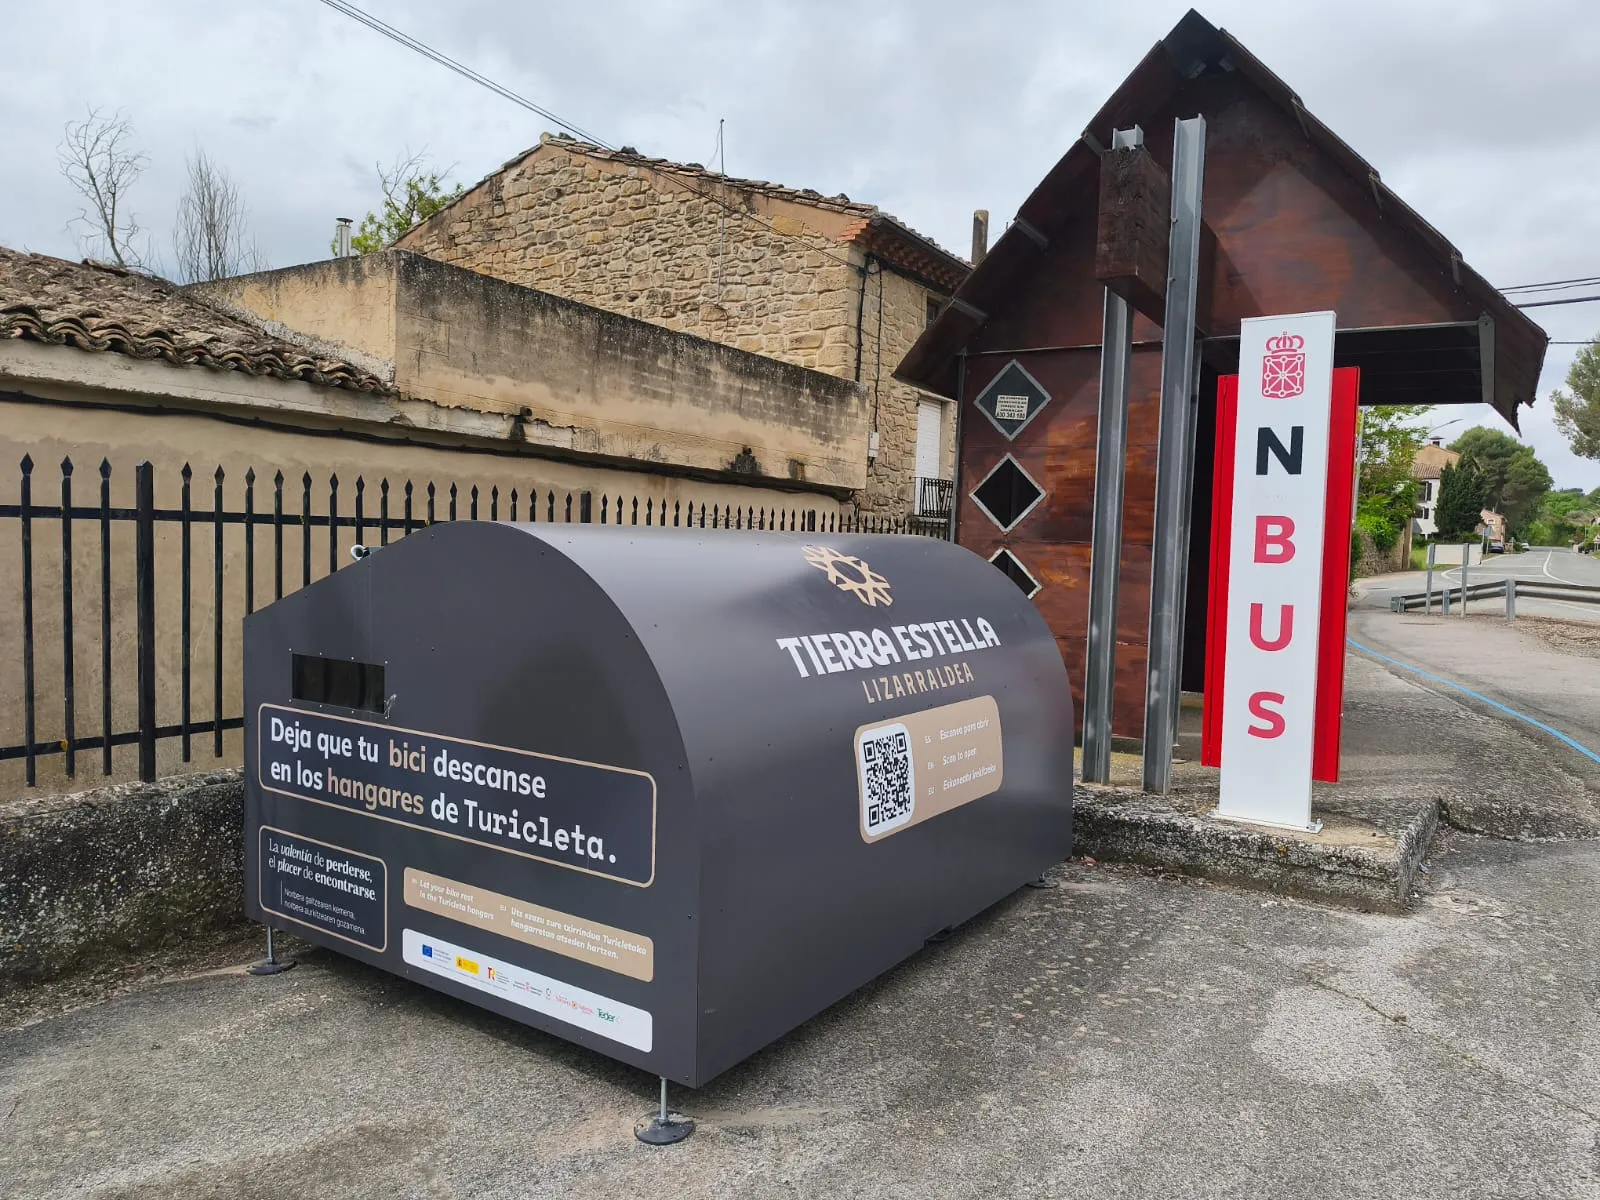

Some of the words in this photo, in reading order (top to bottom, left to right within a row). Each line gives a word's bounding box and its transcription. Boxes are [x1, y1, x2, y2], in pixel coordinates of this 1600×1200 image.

[776, 628, 901, 678] TIERRA
[891, 616, 1001, 661] ESTELLA
[862, 662, 975, 704] LIZARRALDEA
[270, 717, 312, 753] Deja
[317, 732, 352, 760] que
[358, 735, 379, 763] tu
[389, 739, 427, 774] bici
[433, 749, 547, 799] descanse
[942, 754, 957, 766] Scan
[957, 751, 964, 760] to
[270, 761, 291, 784] en
[297, 760, 323, 791] los
[327, 768, 424, 816] hangares
[430, 792, 459, 824] de
[463, 799, 617, 864] Turicleta.
[268, 838, 279, 853] La
[280, 843, 312, 864] valentía
[314, 851, 325, 867] de
[326, 858, 373, 884] perderse,
[268, 856, 276, 868] el
[277, 858, 302, 876] placer
[303, 865, 314, 880] de
[315, 872, 377, 902] encontrarse.
[419, 880, 430, 890] Let
[431, 882, 446, 894] your
[446, 886, 460, 898] bike
[556, 932, 585, 949] atseden
[602, 934, 647, 956] Turicletako
